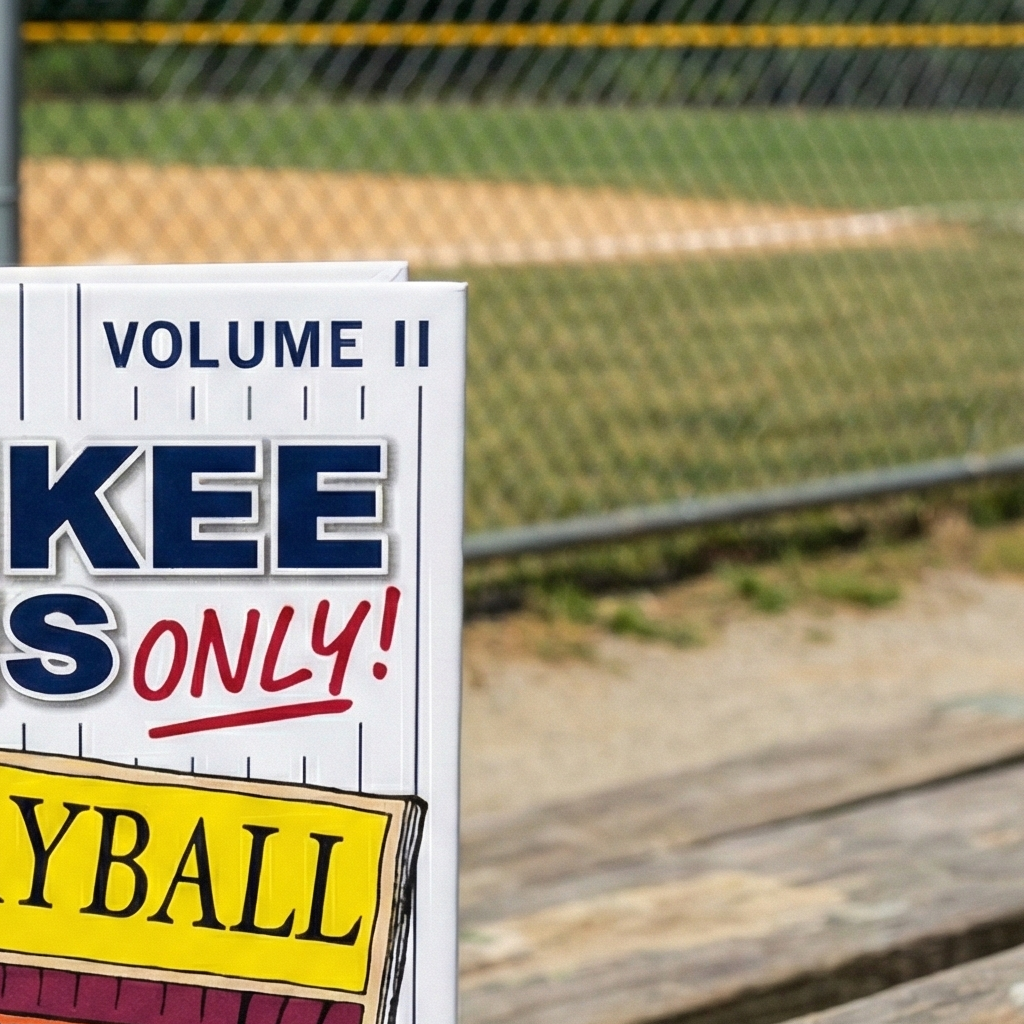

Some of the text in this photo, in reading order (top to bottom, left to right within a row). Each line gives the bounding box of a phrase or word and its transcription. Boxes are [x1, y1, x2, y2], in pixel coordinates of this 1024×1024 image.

[102, 320, 429, 369] VOLUME II
[133, 586, 401, 702] ONLY!
